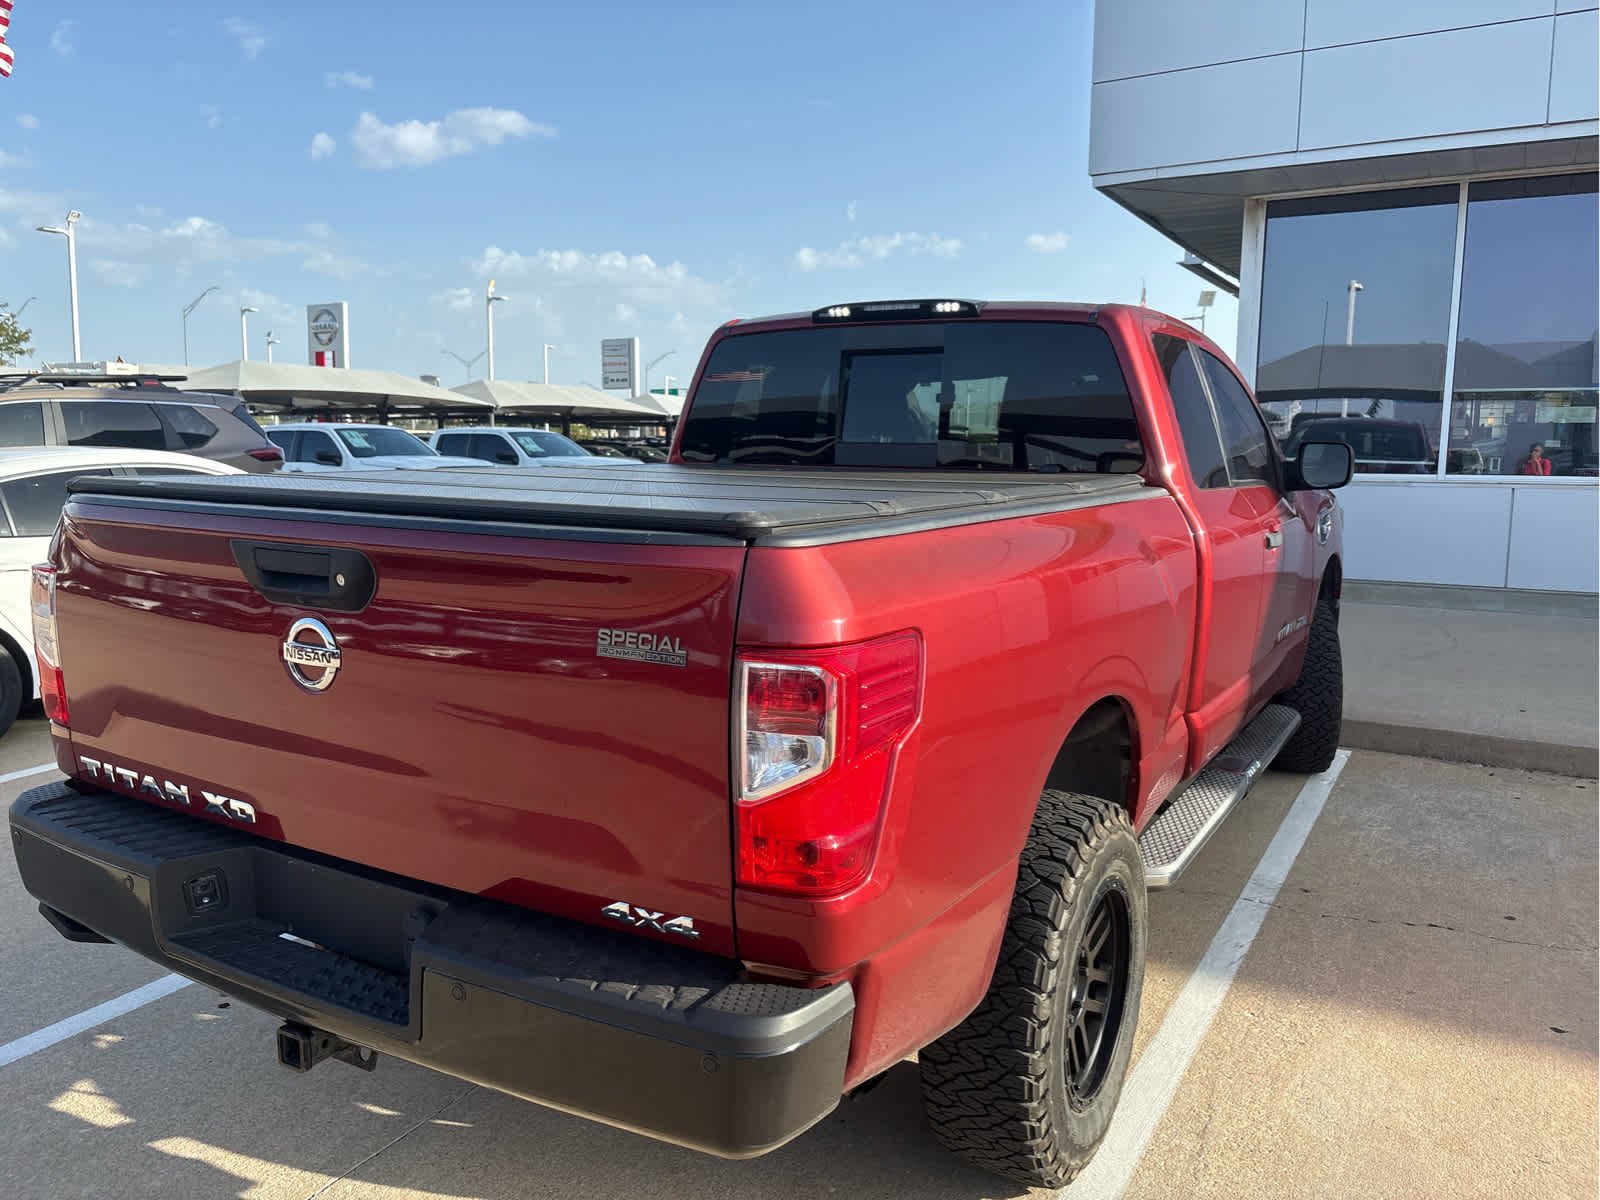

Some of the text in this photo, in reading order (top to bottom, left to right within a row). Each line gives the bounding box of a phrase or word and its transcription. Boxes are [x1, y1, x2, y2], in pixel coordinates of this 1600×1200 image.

[598, 628, 687, 653] SPECIAL
[285, 648, 332, 664] NISSAN
[646, 652, 685, 664] EDITION
[80, 756, 256, 824] TITAN XD
